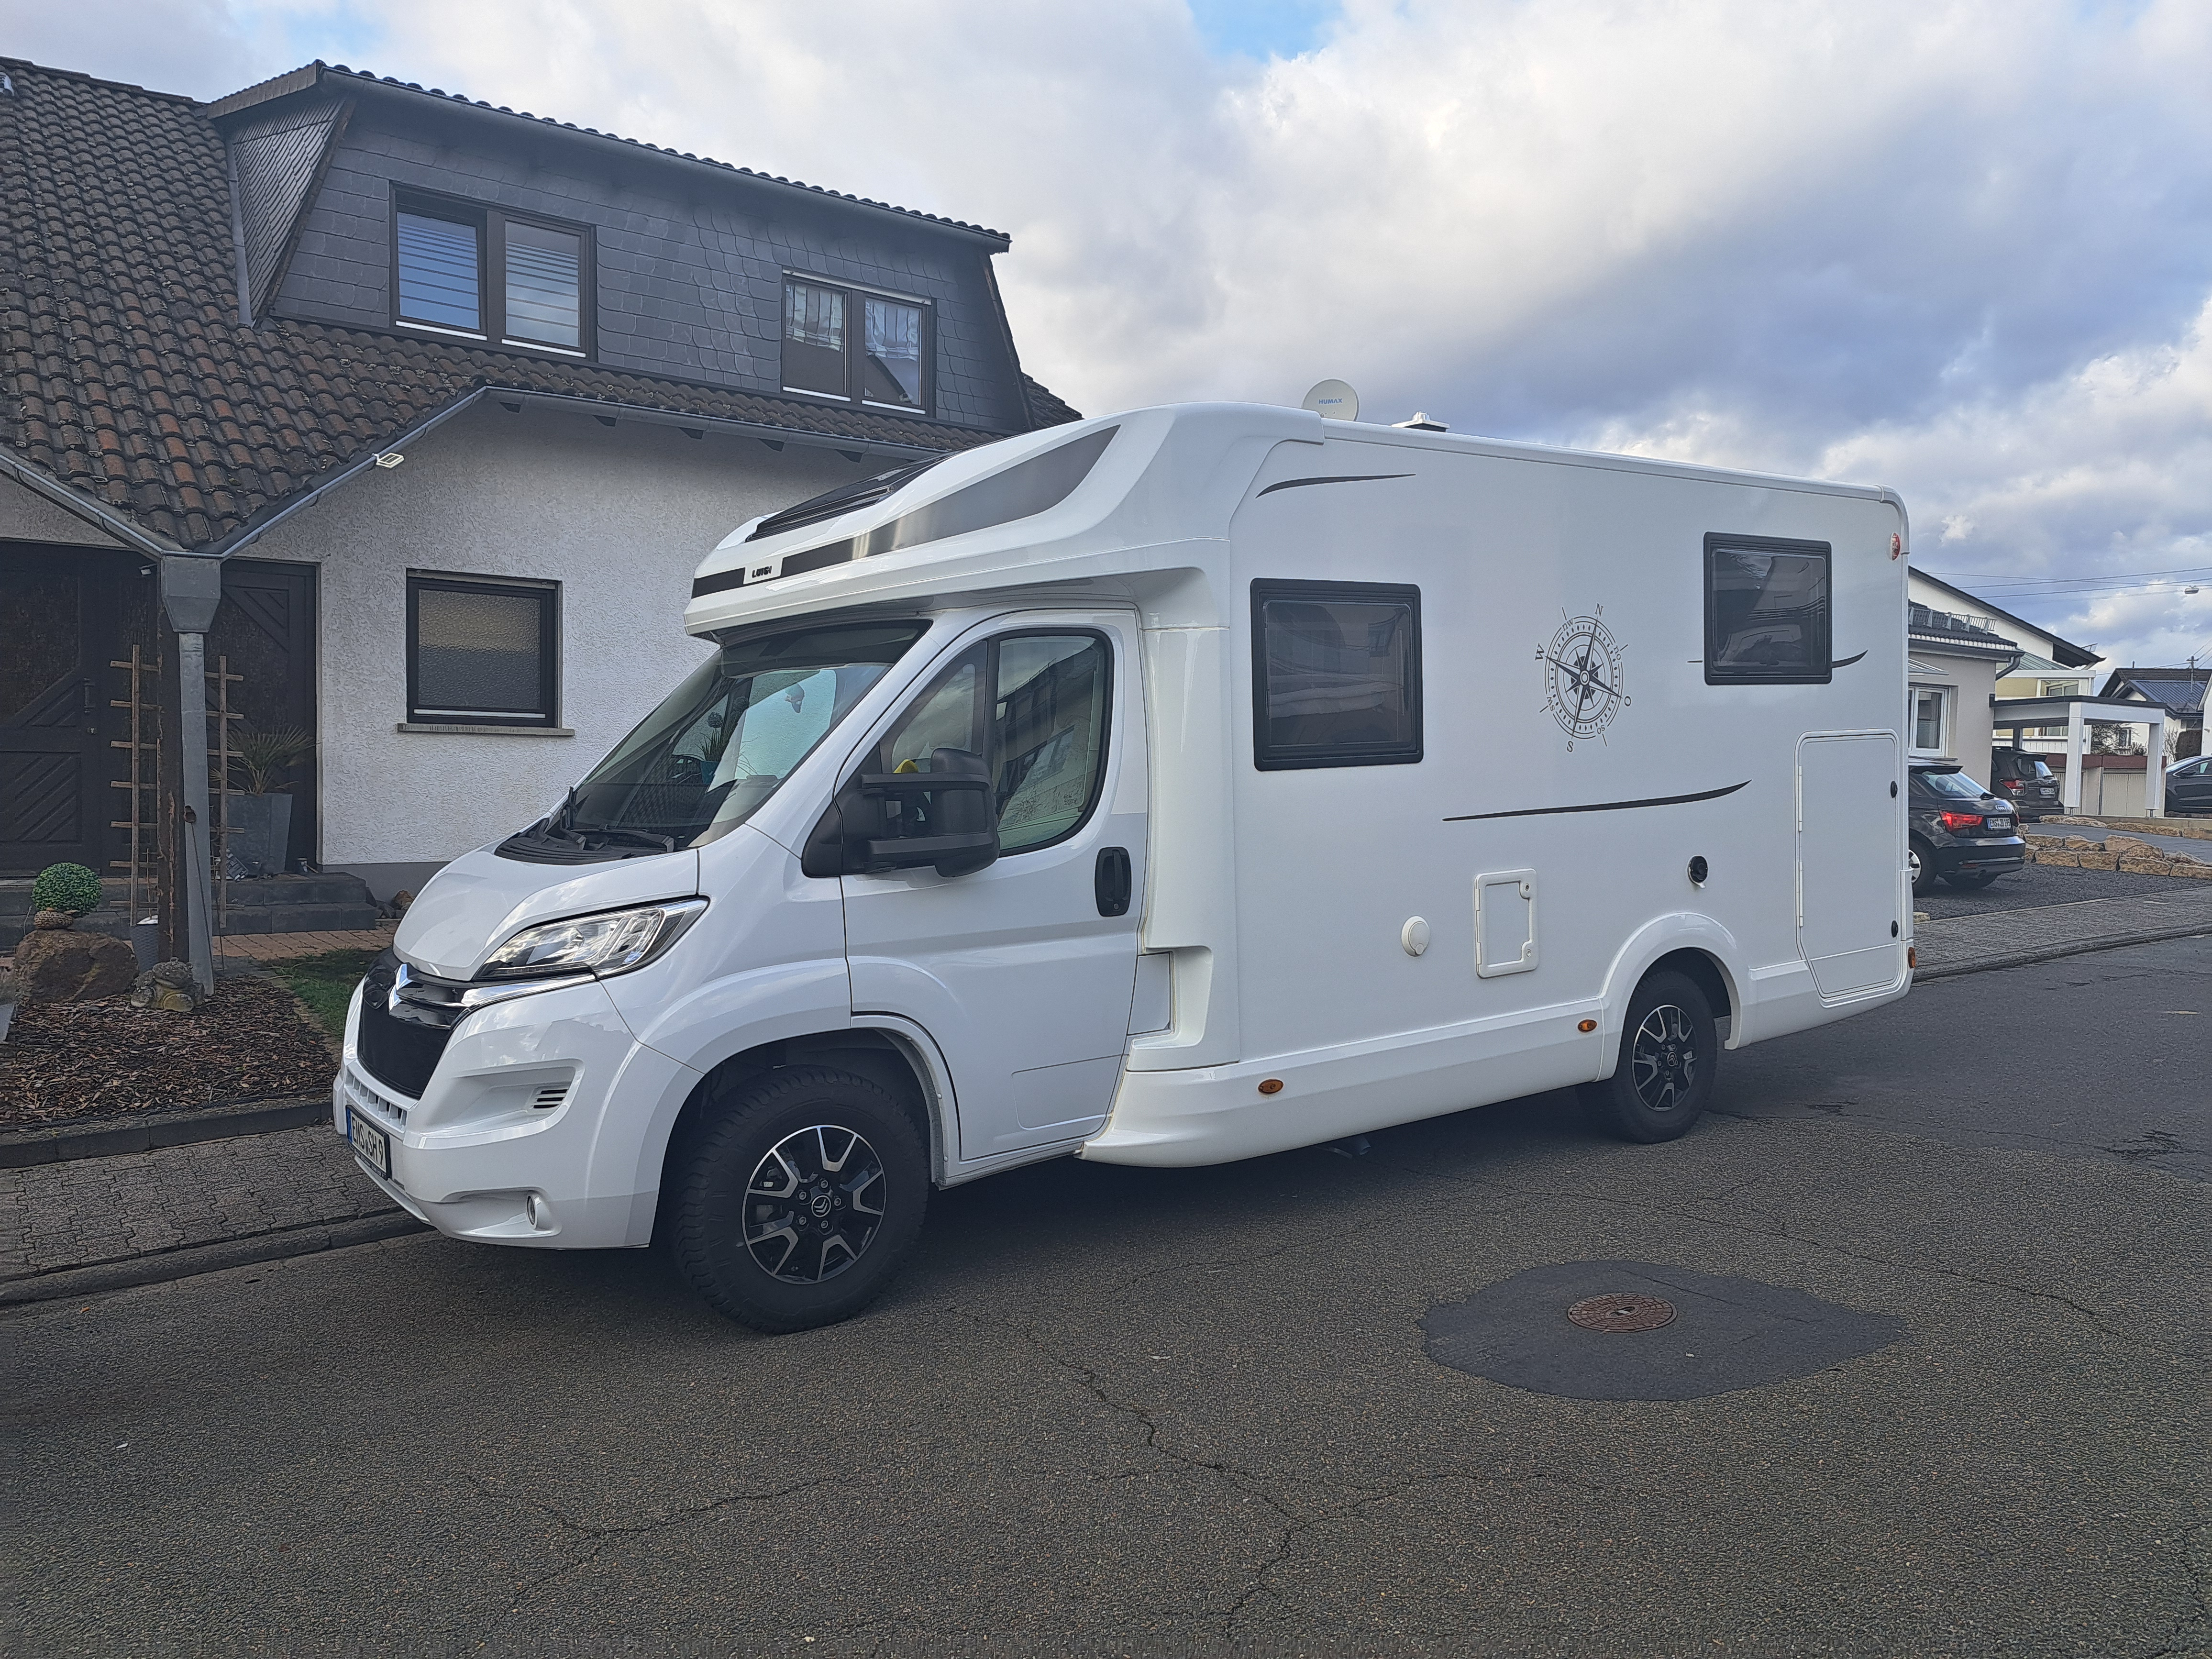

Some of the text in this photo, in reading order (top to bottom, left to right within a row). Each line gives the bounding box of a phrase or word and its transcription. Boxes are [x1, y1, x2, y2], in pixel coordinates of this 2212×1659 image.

[752, 565, 772, 578] LUIGI
[1594, 603, 1604, 617] N
[1535, 642, 1545, 661] W
[1624, 696, 1632, 707] O
[1567, 741, 1574, 752] S
[352, 1116, 365, 1150] EMS
[368, 1129, 378, 1162] SH
[379, 1138, 383, 1166] 9
